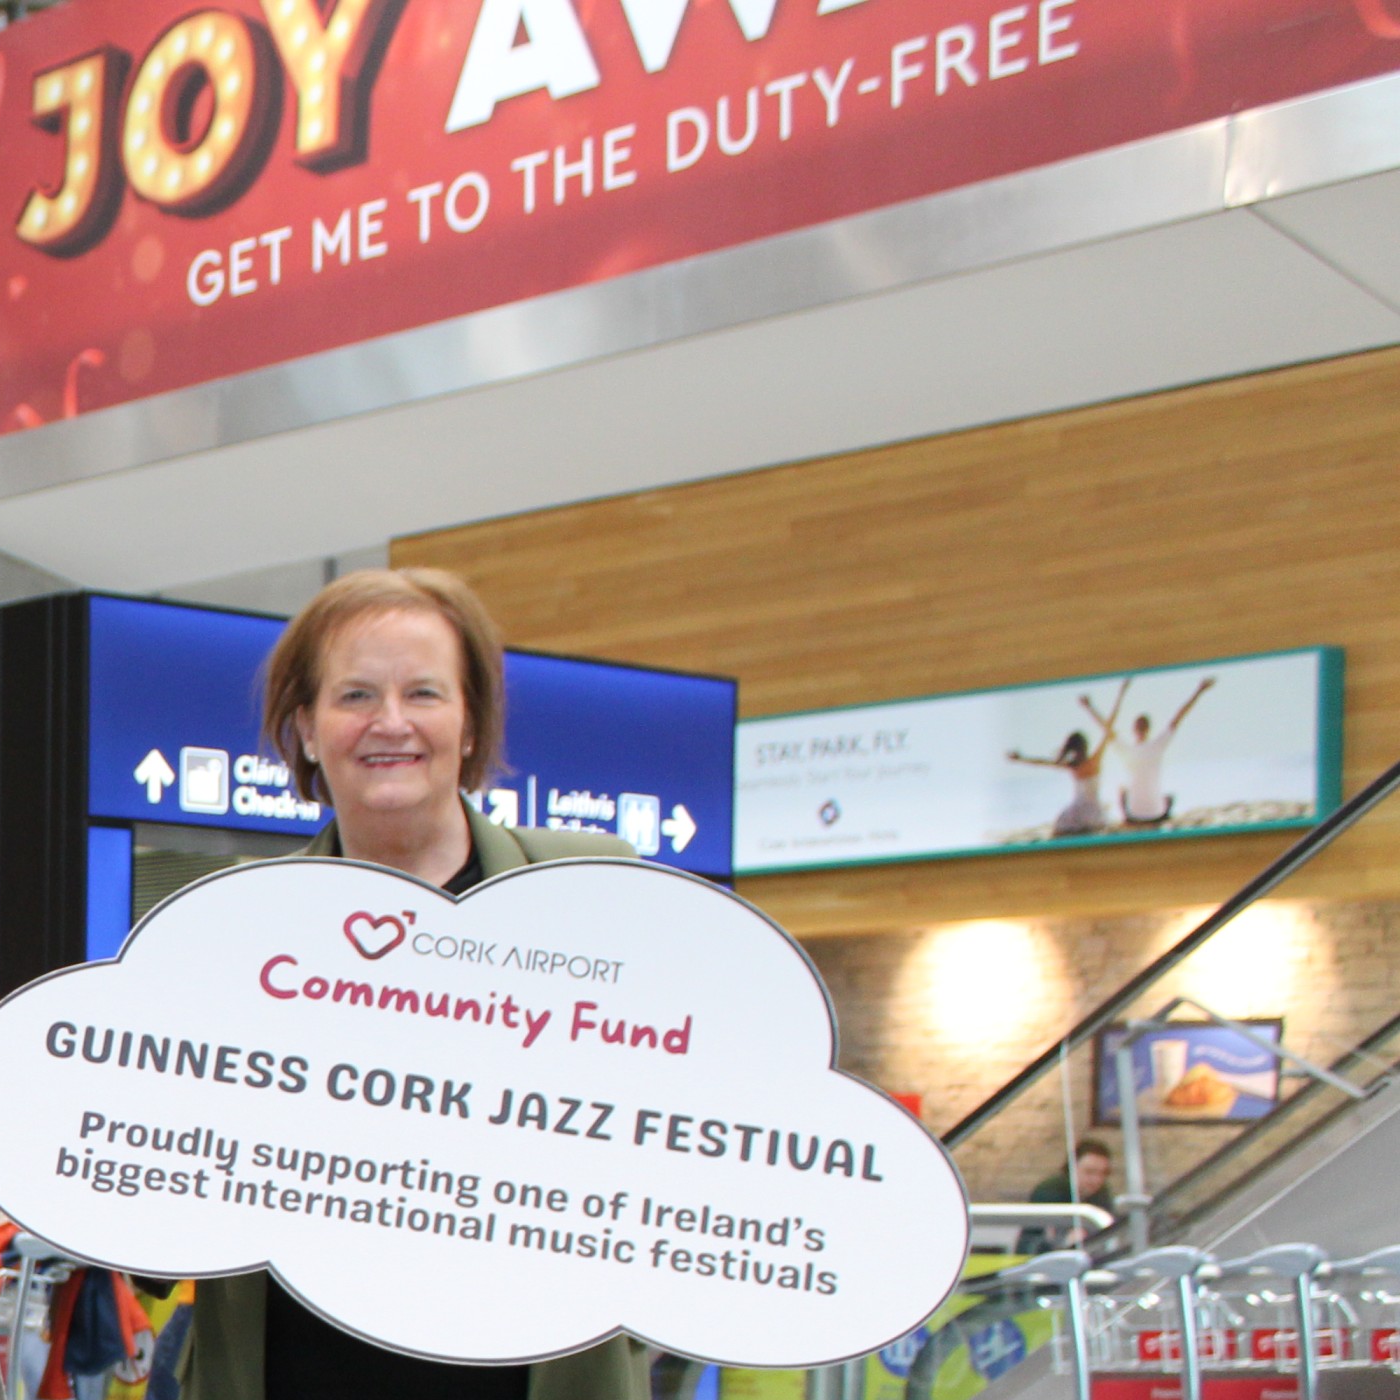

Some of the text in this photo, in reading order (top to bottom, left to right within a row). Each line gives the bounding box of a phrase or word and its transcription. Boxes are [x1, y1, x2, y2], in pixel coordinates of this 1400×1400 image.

[16, 0, 390, 252] JOY
[186, 0, 1081, 306] GET ME TO THE DUTY-FREE
[259, 953, 694, 1055] Community Fund
[411, 931, 625, 984] CORK AIRPORT
[45, 1020, 885, 1183] GUINNESS CORK JAZZ FESTIVAL
[55, 1146, 838, 1296] biggest international music festivals
[79, 1110, 827, 1252] Proudly supporting one of Ireland's
